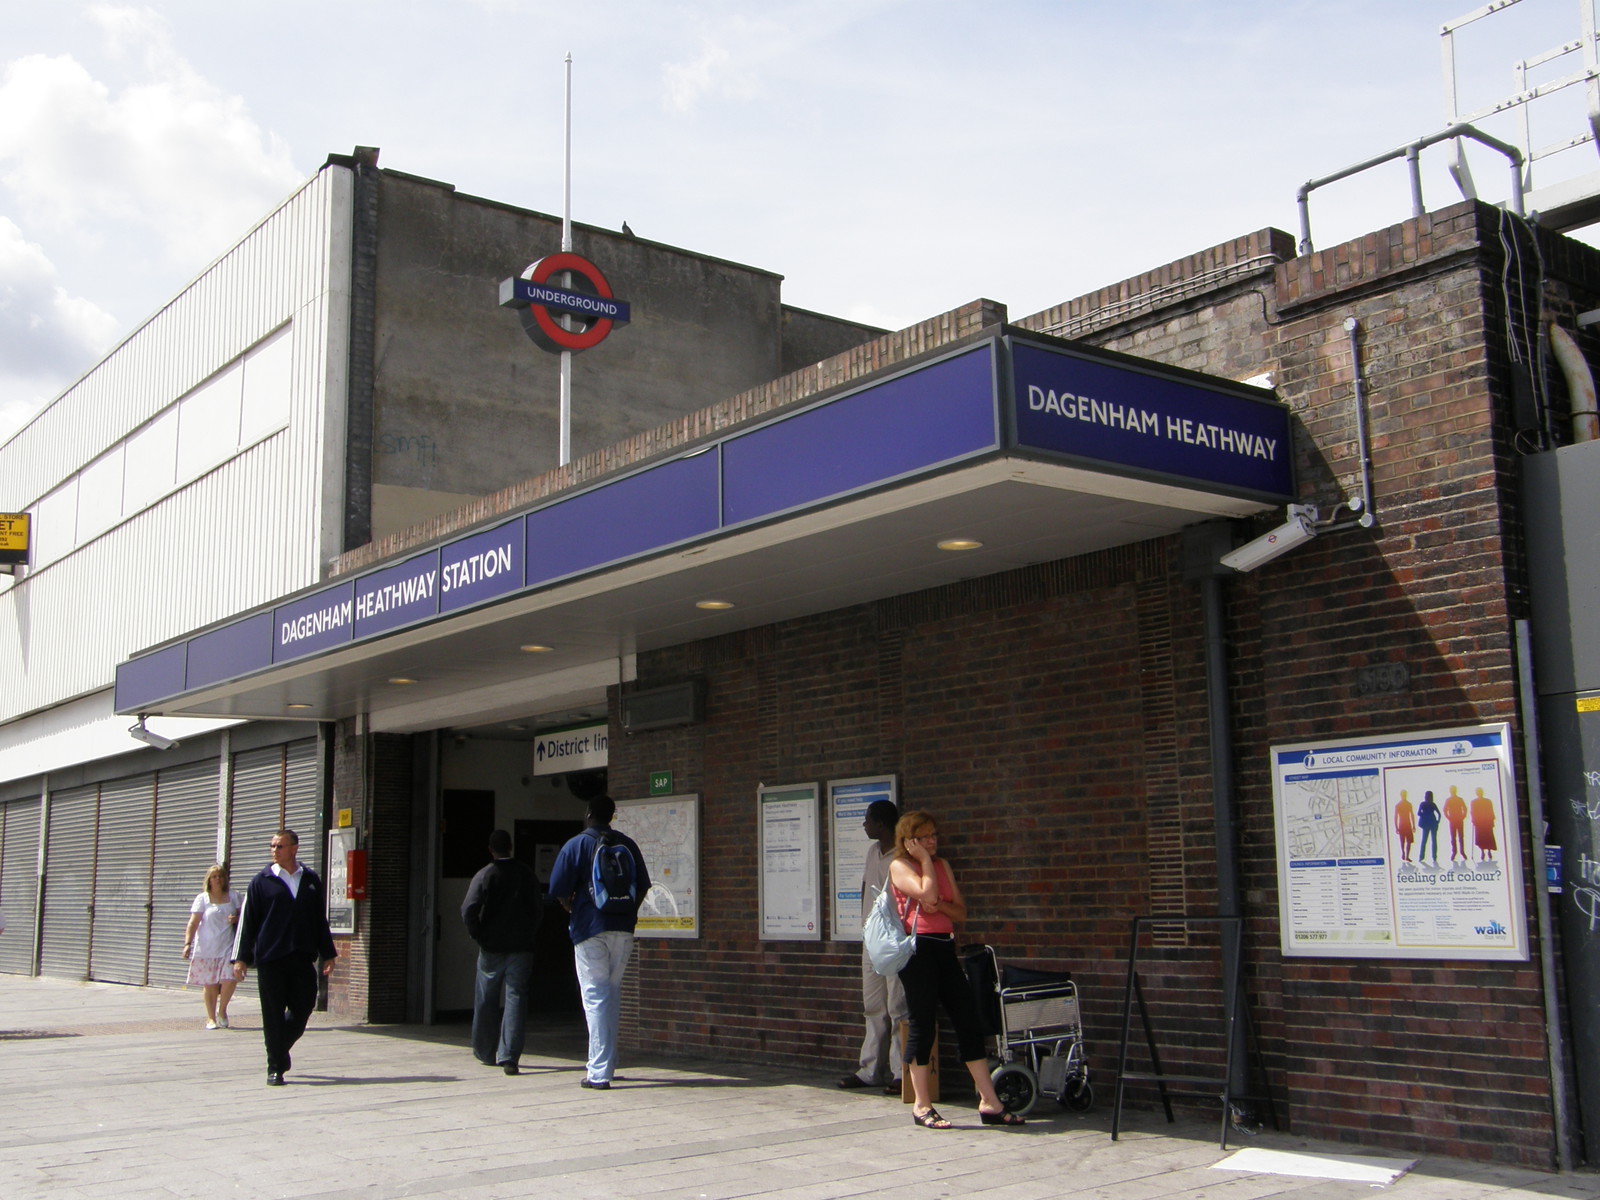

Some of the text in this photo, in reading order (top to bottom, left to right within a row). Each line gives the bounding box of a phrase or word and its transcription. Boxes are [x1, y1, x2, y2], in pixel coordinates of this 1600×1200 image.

[527, 286, 618, 315] UNDERGROUND
[1027, 384, 1276, 461] DAGENHAM HEATHWAY
[281, 544, 512, 645] DAGENHAM HEATHWAY STATION
[547, 737, 590, 758] District
[1322, 748, 1438, 765] LOCAL COMMUNITY INFORMATION
[655, 778, 668, 788] SAP
[1396, 870, 1501, 885] feeling off colour?
[1473, 921, 1507, 935] walk
